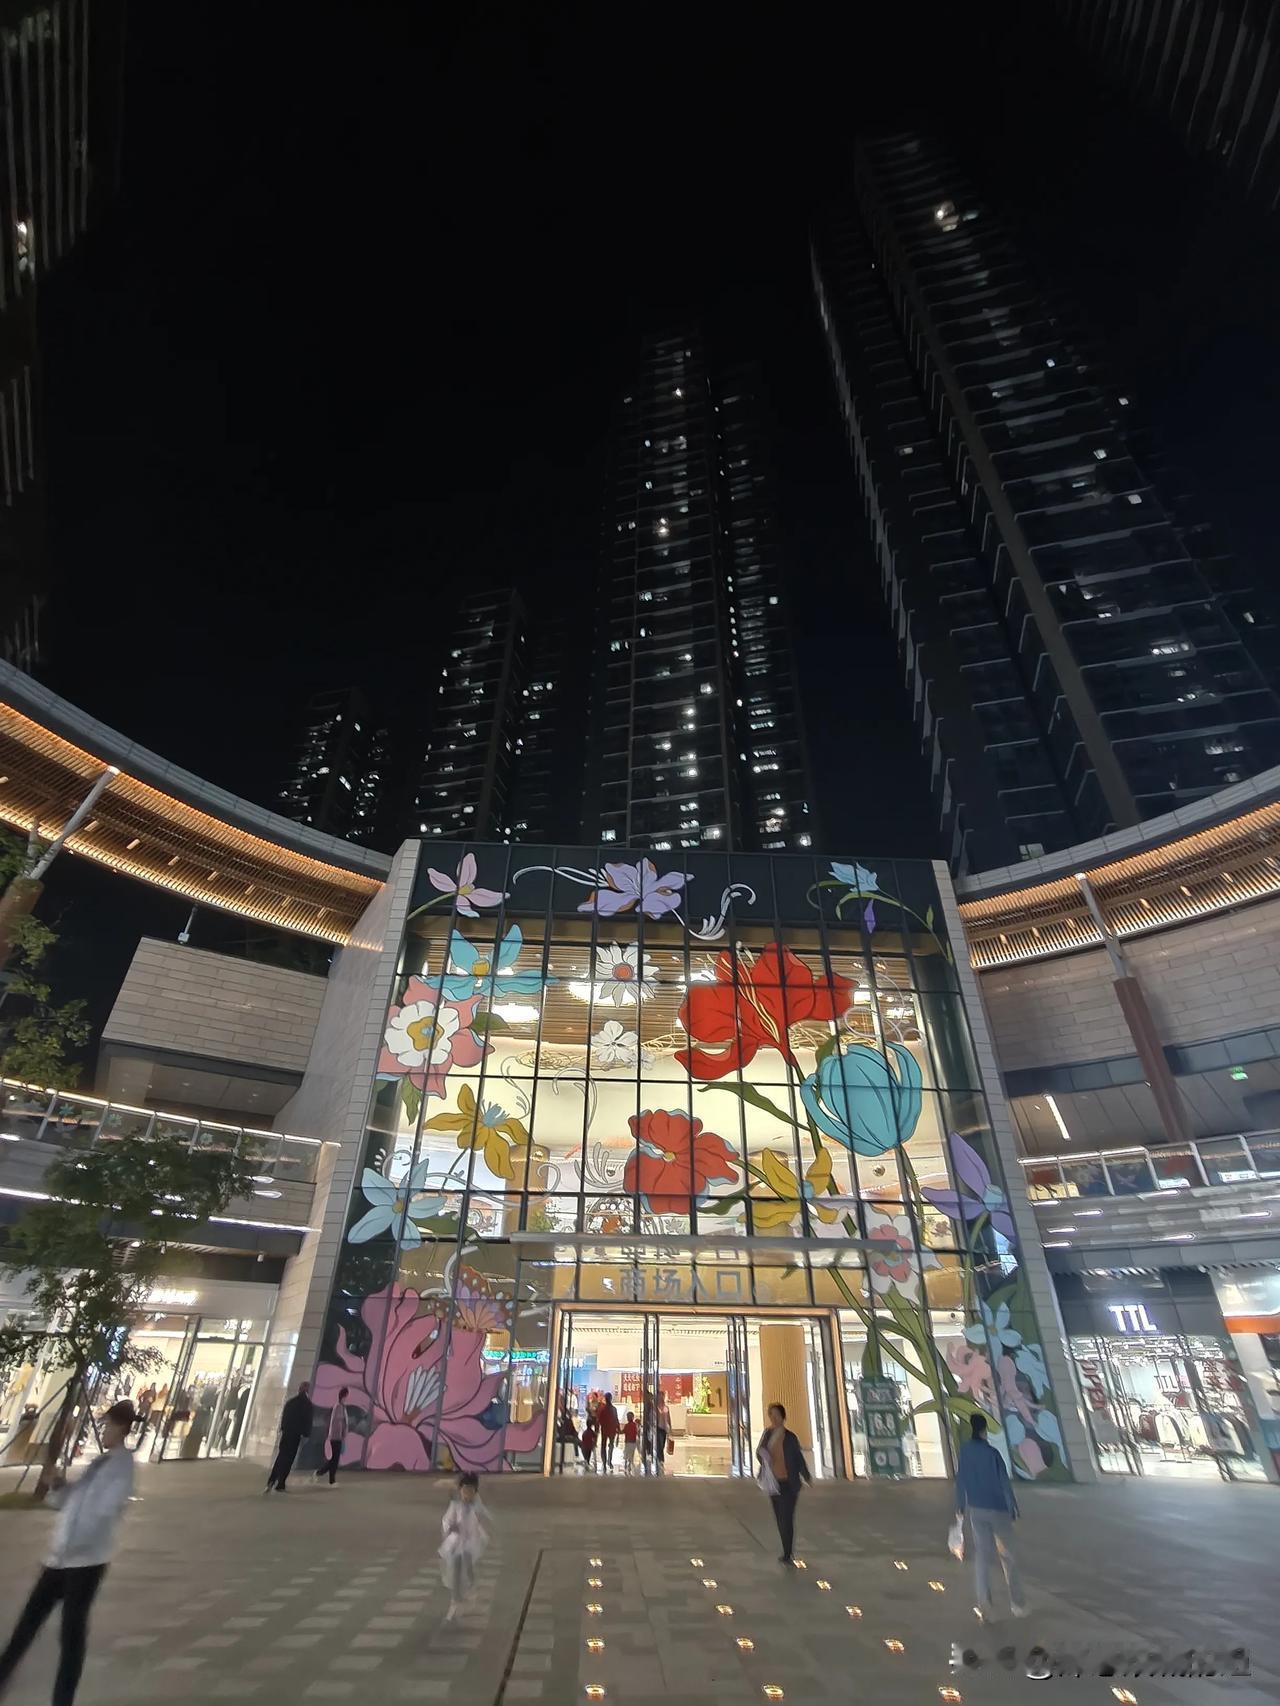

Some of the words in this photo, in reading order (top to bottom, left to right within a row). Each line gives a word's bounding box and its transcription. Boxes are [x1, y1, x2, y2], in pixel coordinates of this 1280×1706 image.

[619, 1267, 741, 1300] 商场入口
[1108, 1304, 1157, 1331] TTL
